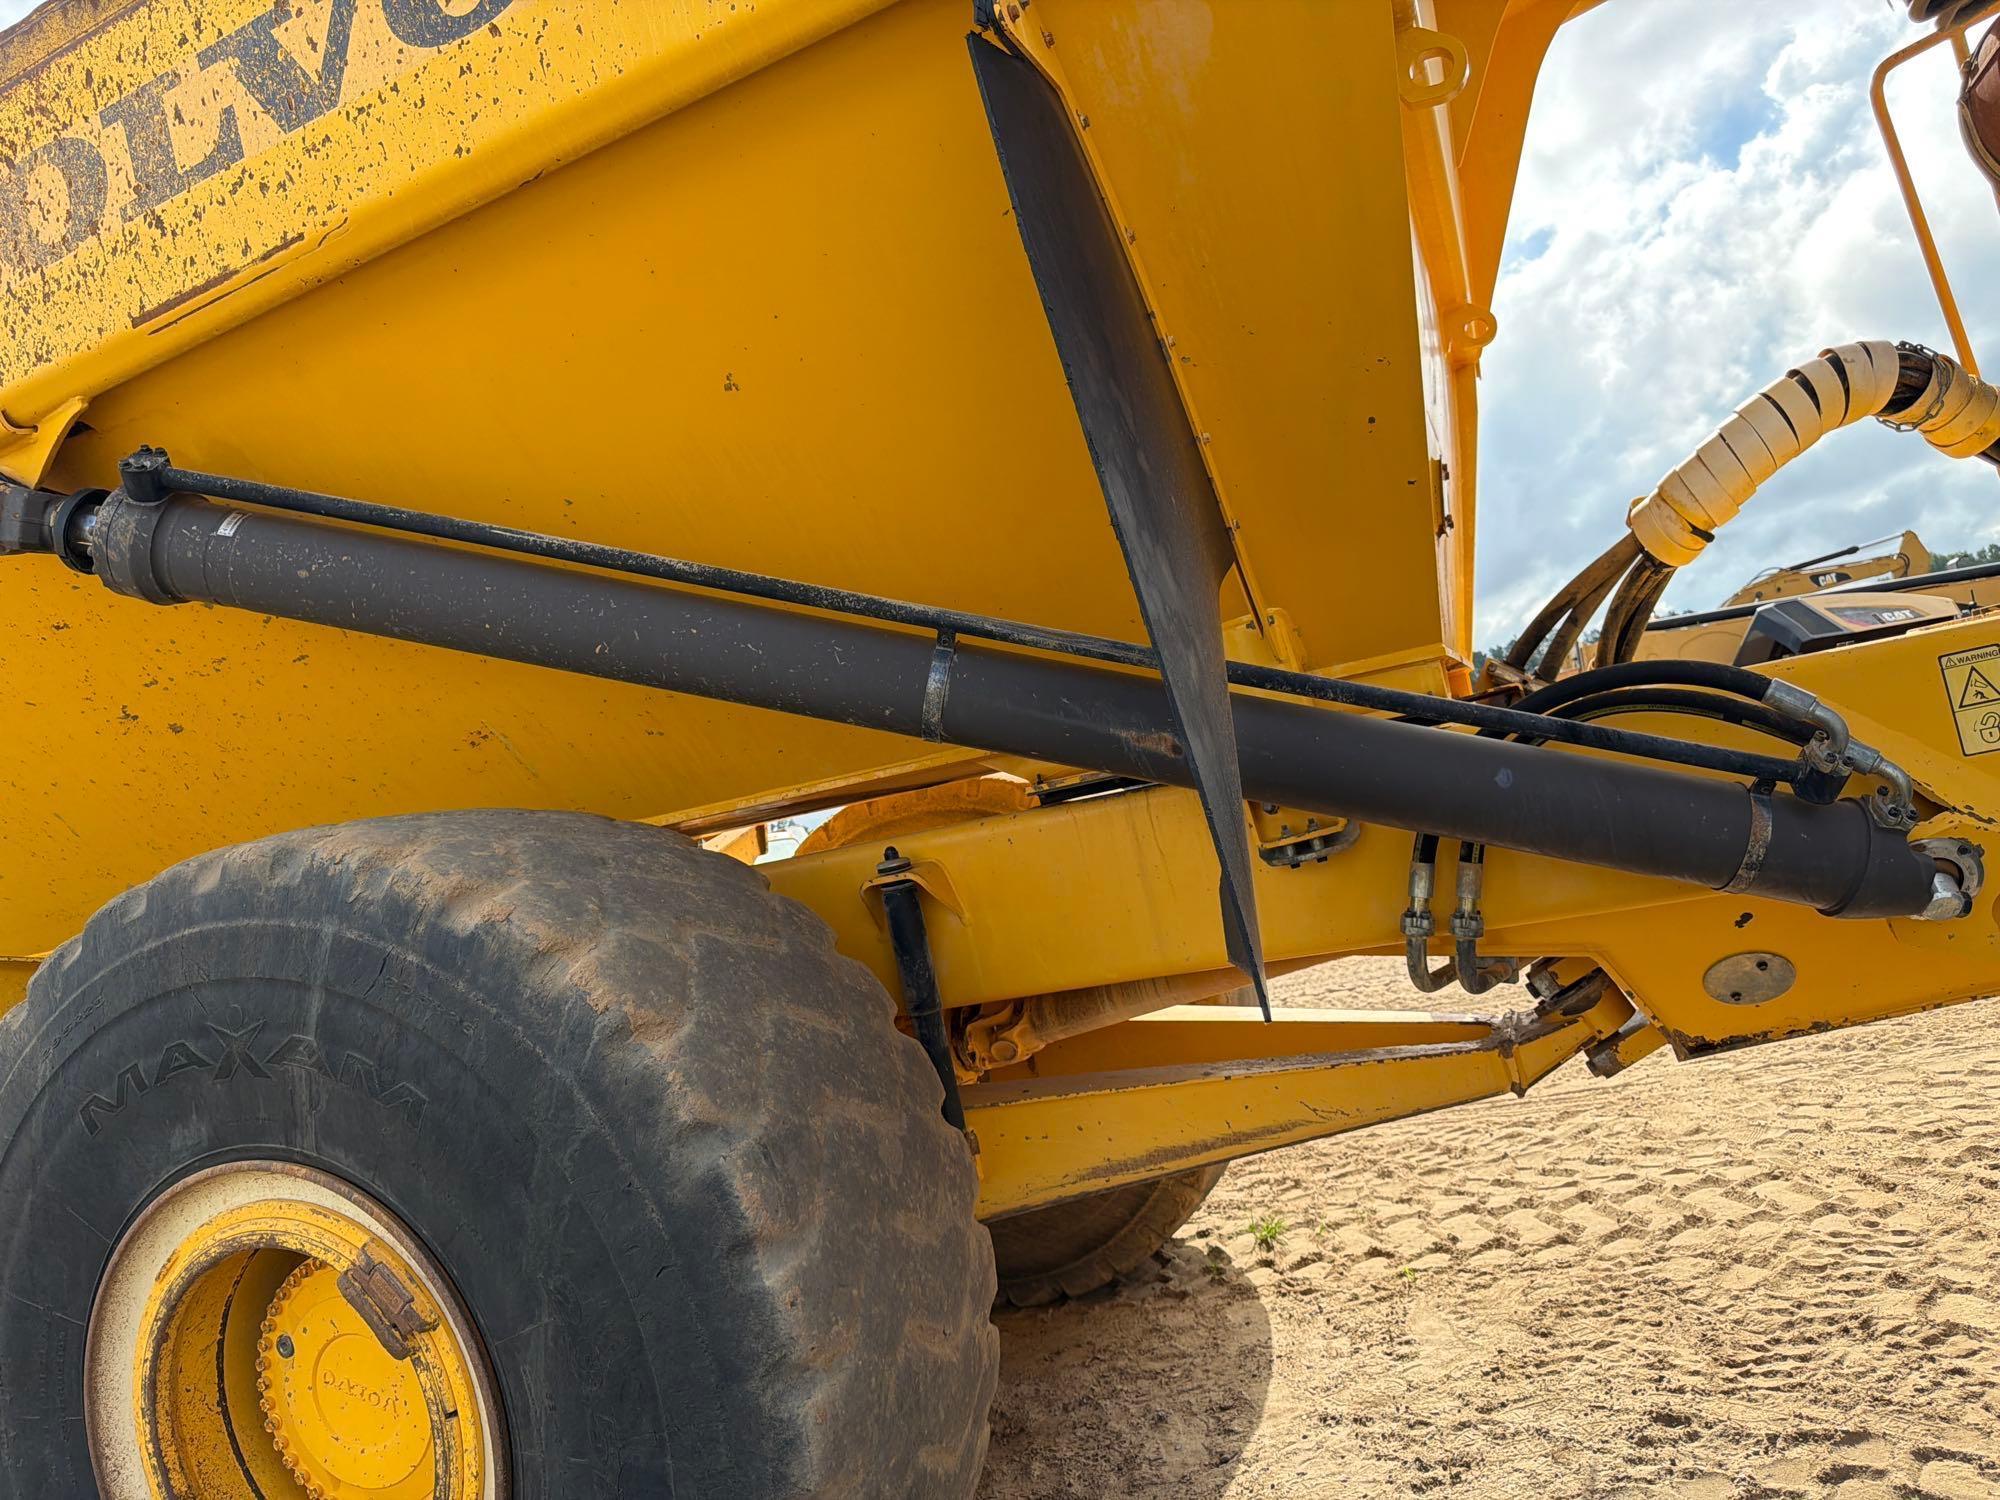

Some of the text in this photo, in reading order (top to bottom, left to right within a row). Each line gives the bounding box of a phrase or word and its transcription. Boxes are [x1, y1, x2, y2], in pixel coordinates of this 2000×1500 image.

[1818, 573, 1837, 587] CAT
[1882, 609, 1914, 621] CAT
[1956, 650, 1999, 664] WARNING
[79, 1019, 429, 1137] MAXAM
